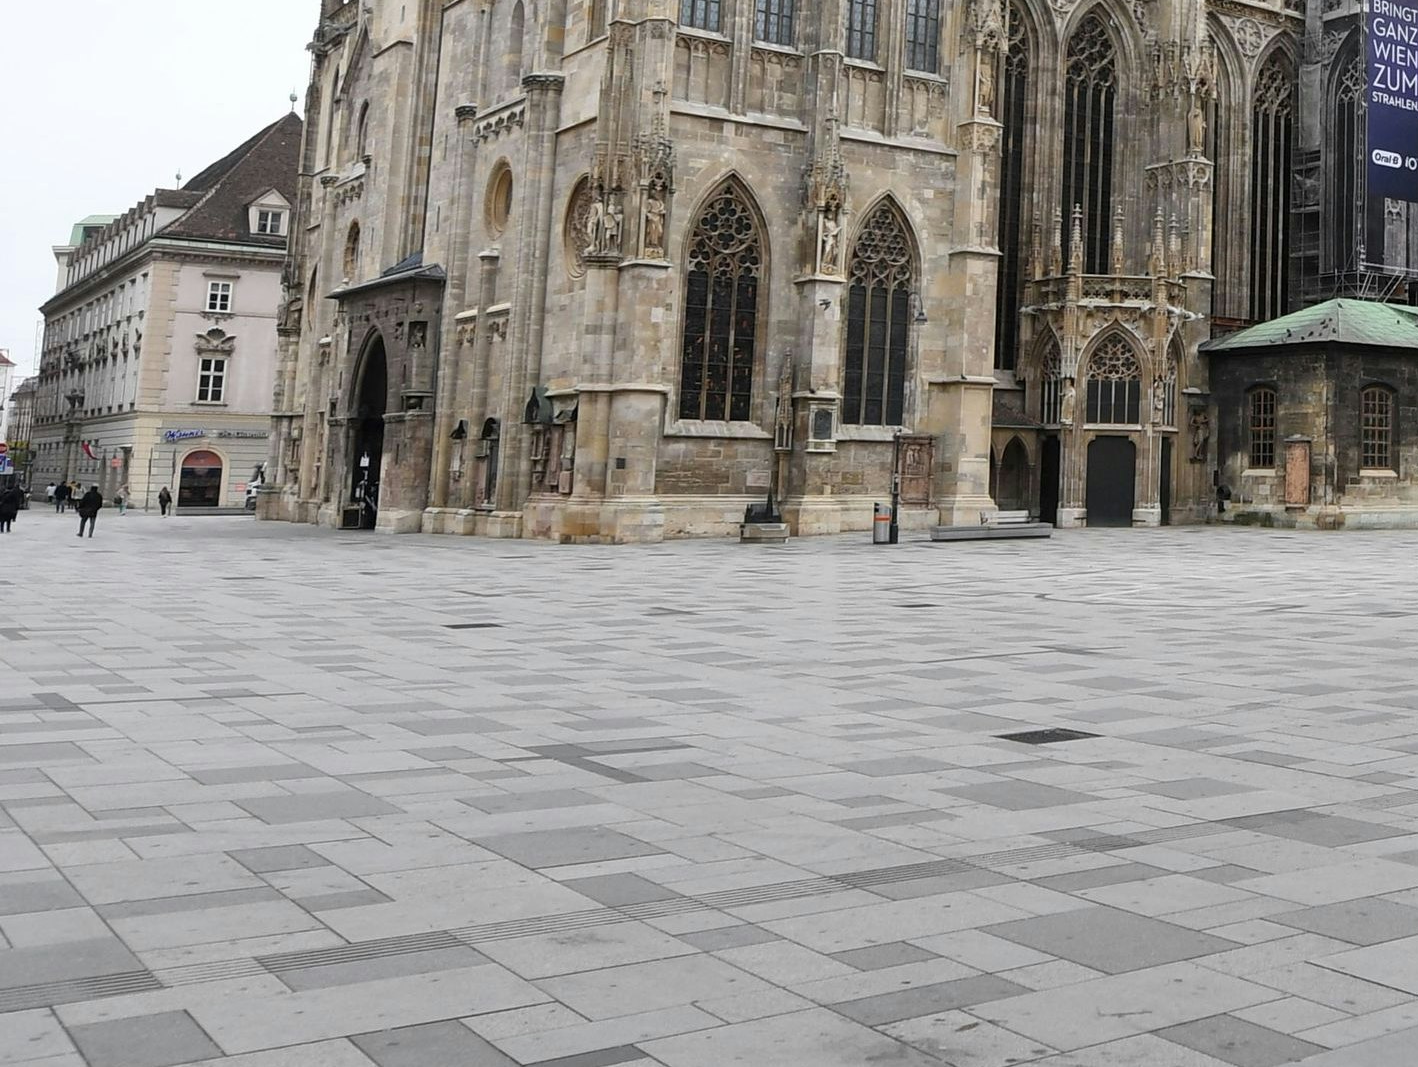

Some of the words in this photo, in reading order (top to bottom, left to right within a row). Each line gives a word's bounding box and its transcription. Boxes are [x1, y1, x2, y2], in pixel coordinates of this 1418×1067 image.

[1373, 17, 1418, 46] GANZ
[1373, 38, 1418, 69] WIEN
[1372, 63, 1418, 97] ZUM
